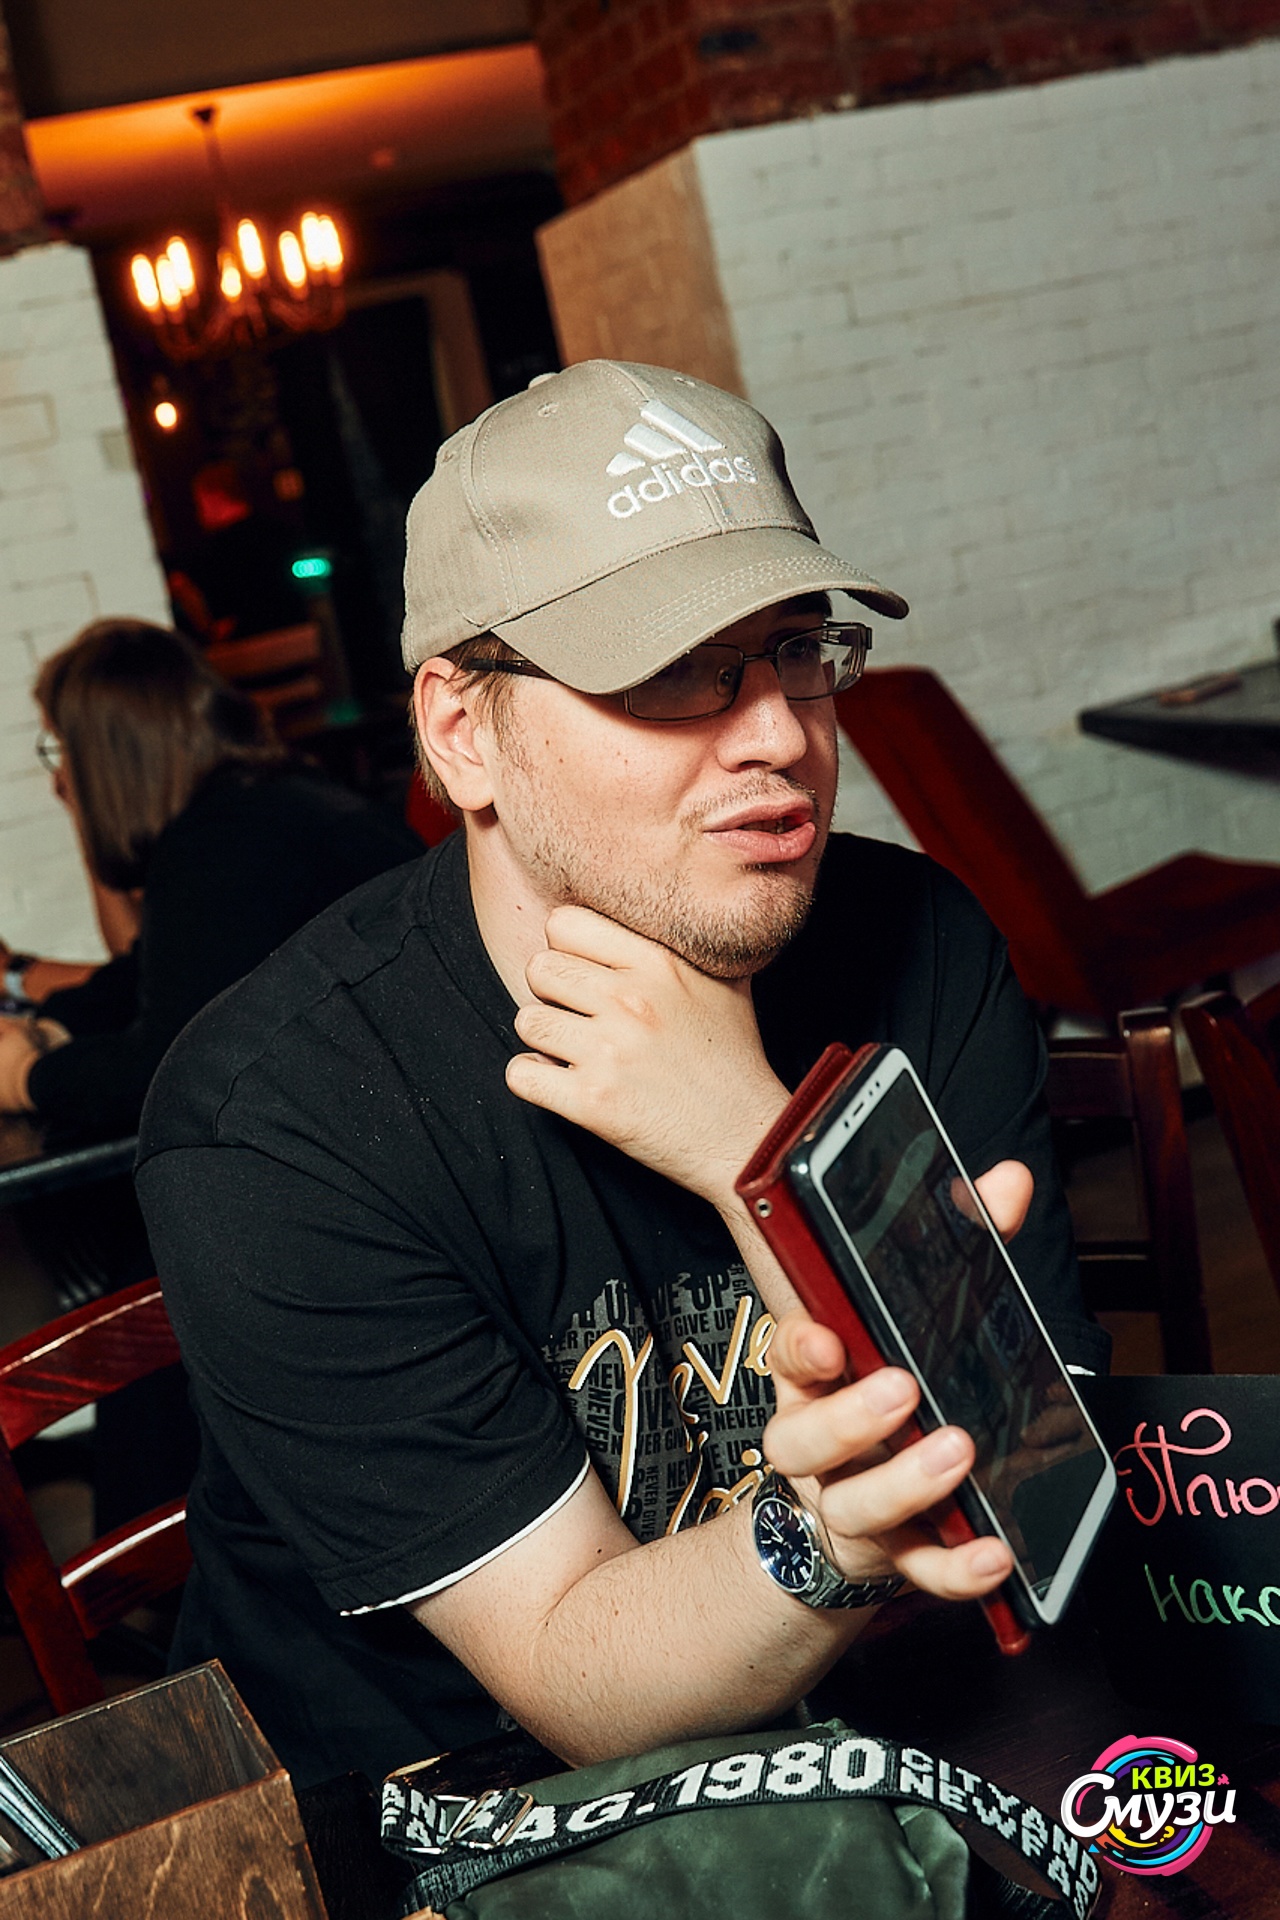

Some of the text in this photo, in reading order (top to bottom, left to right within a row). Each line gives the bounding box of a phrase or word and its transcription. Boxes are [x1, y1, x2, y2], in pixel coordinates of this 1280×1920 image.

[607, 455, 758, 519] adidas
[674, 1312, 710, 1337] GIVE
[713, 1406, 768, 1431] NEVER
[1113, 1407, 1280, 1526] Плю
[668, 1737, 887, 1806] 1980
[900, 1766, 1017, 1840] NEW
[901, 1747, 1021, 1815] CITY
